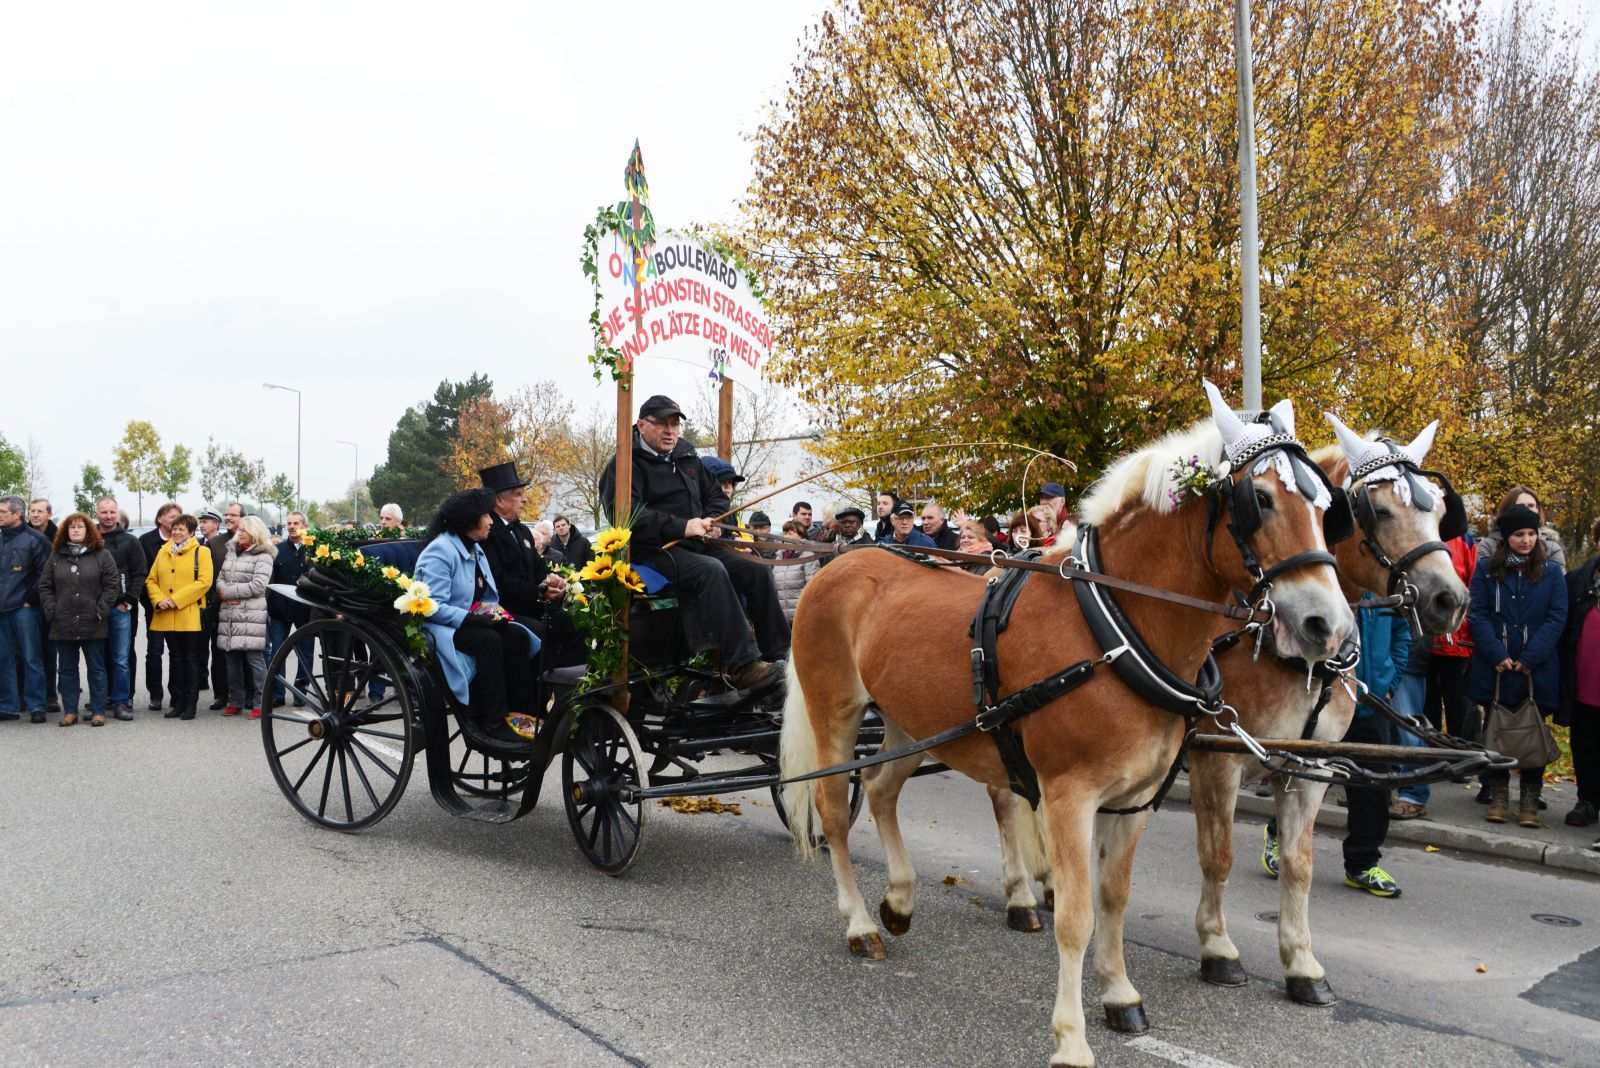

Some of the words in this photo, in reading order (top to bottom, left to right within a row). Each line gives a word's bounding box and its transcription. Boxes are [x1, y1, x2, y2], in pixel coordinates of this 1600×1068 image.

[600, 306, 625, 347] DIE
[624, 277, 710, 322] SCHÖNSTEN
[713, 290, 775, 351] STRASSEN
[616, 328, 649, 372] UND
[650, 310, 700, 345] PLÄTZE
[702, 317, 727, 348] DER
[730, 332, 760, 370] WELT
